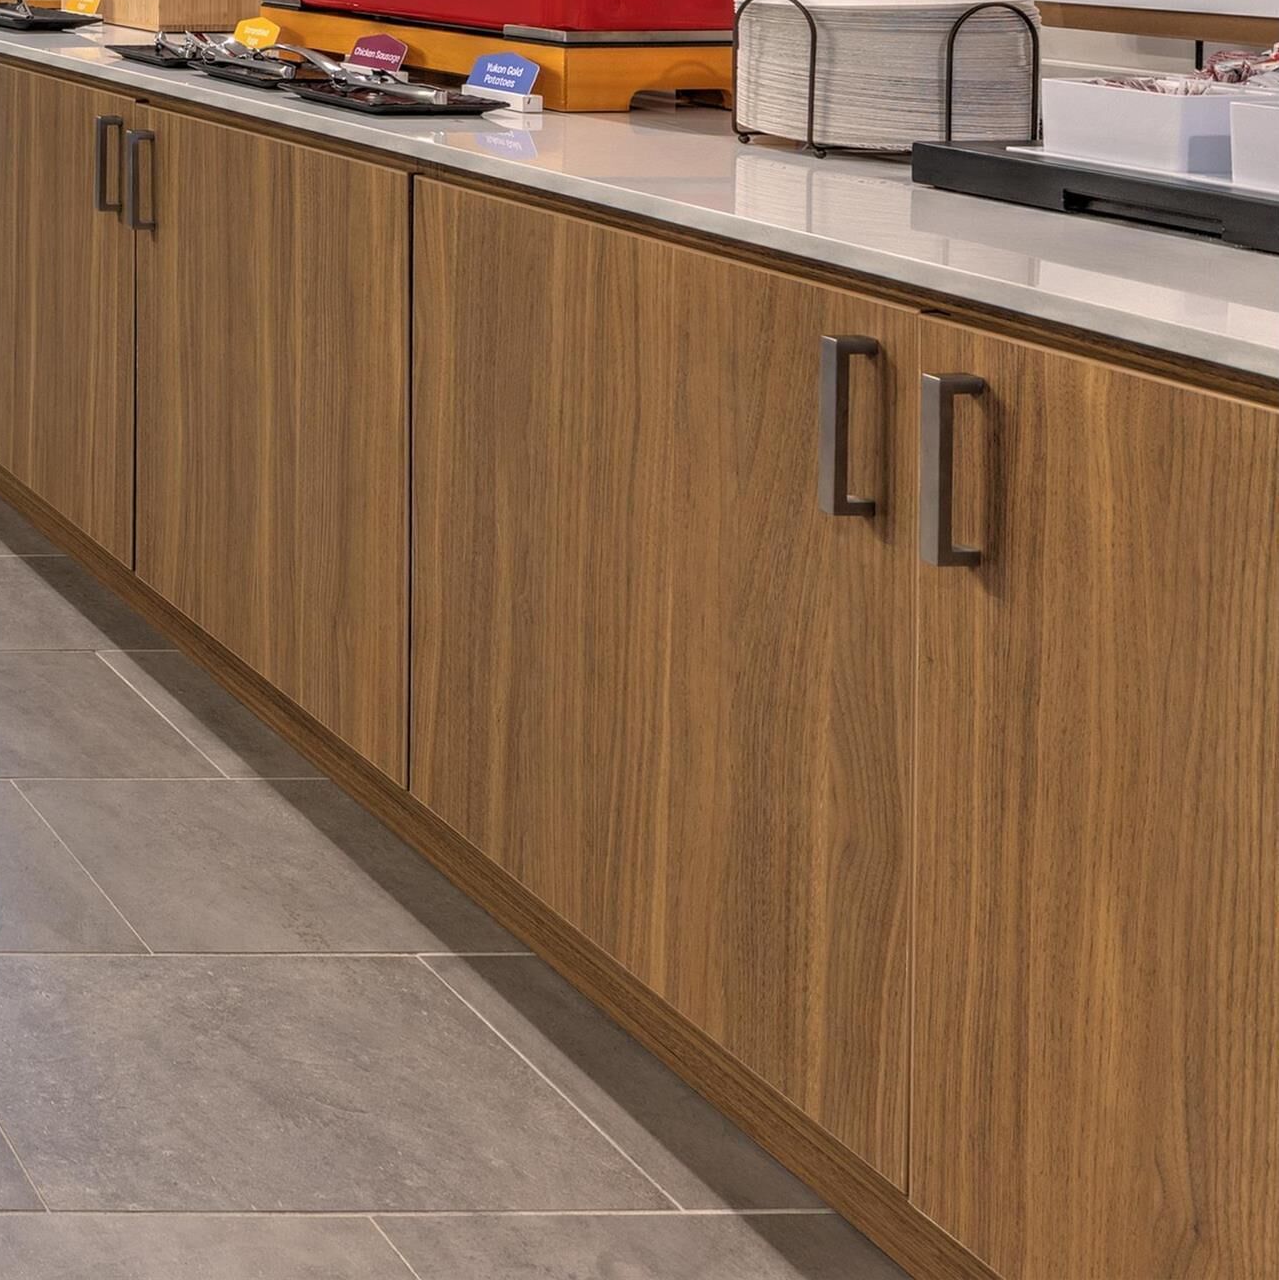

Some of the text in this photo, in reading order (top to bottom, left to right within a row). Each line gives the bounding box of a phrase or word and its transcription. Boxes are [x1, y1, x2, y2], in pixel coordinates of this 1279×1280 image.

[354, 46, 401, 64] Chicken Sausage
[487, 62, 524, 77] Yukon Gold
[483, 74, 516, 88] Potatoes
